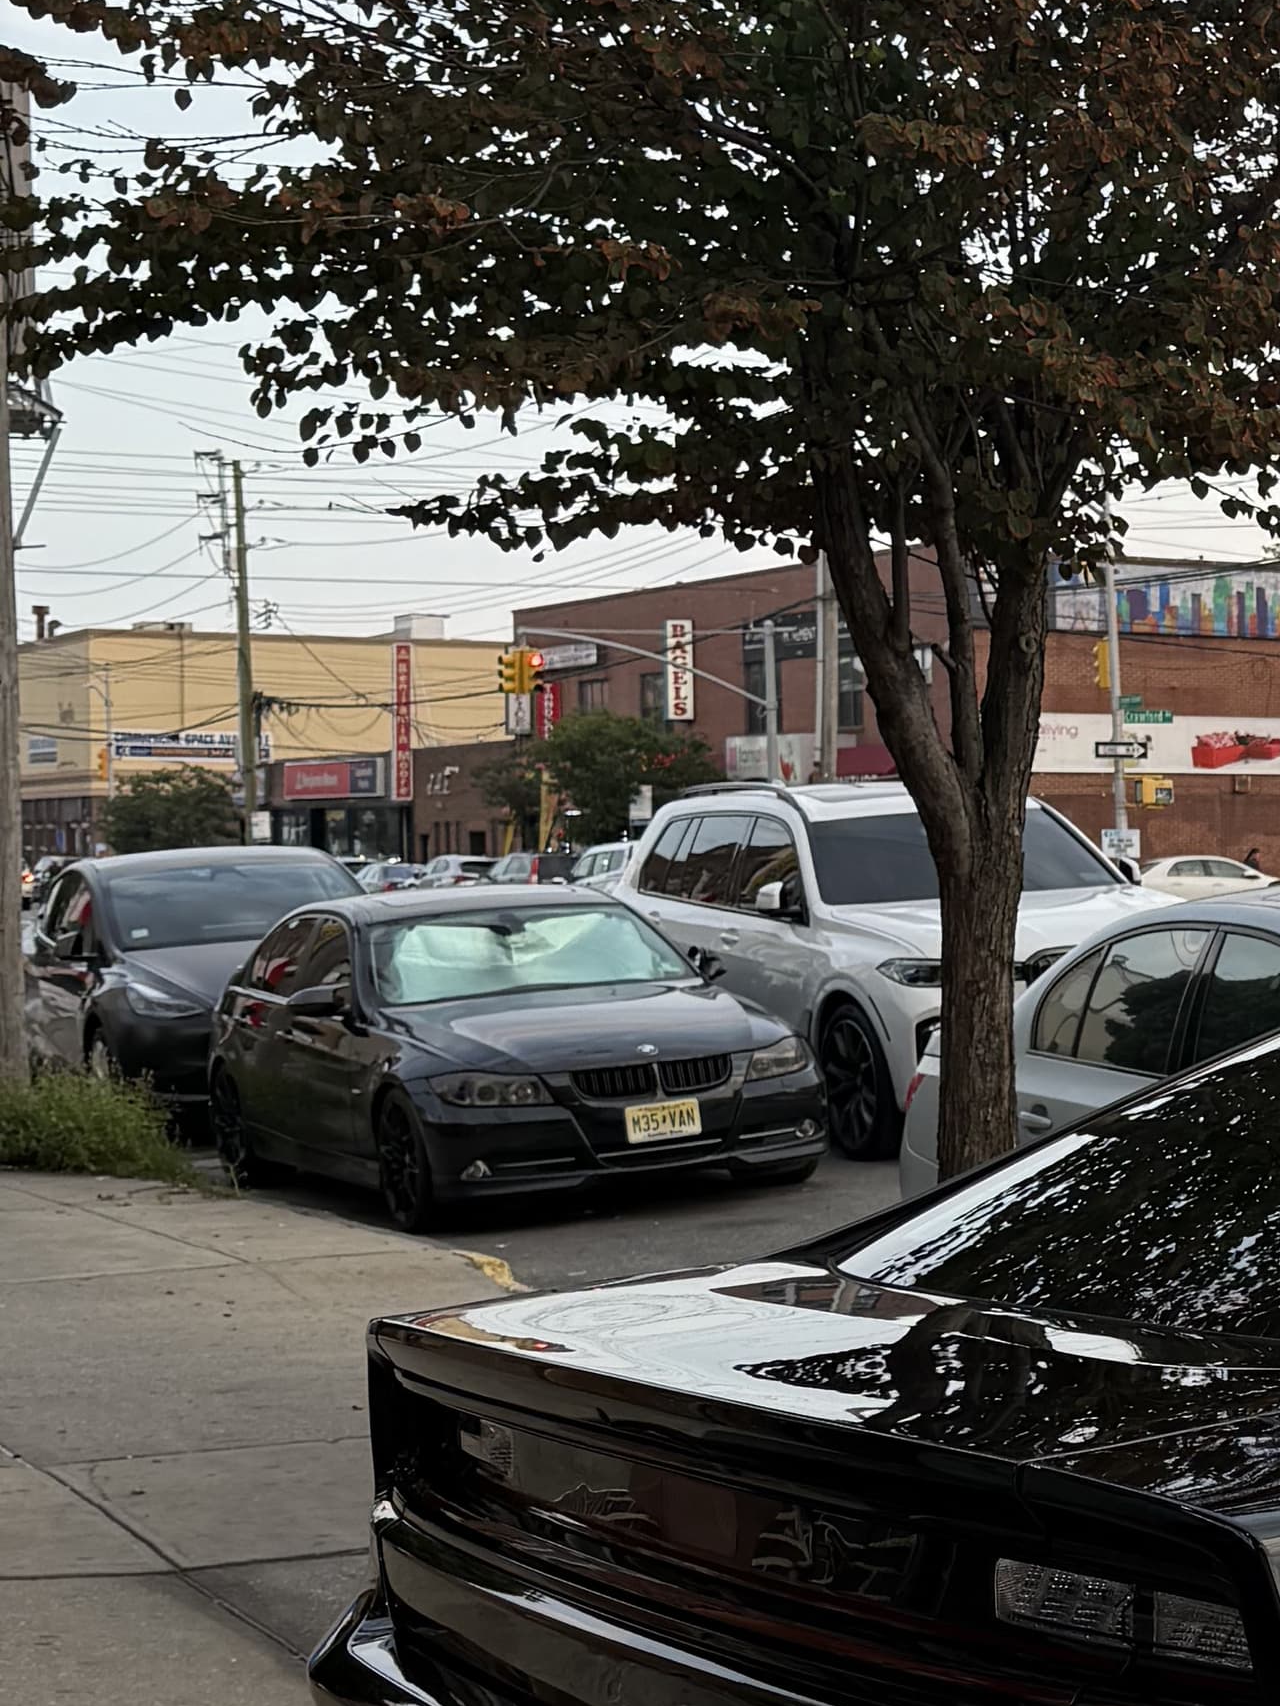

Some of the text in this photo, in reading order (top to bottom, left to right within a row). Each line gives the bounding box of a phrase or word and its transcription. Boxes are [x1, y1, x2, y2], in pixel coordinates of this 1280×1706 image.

[671, 624, 689, 717] BAGELS
[1125, 710, 1163, 724] Crawford
[632, 1112, 660, 1134] M35
[668, 1107, 696, 1128] VAN
